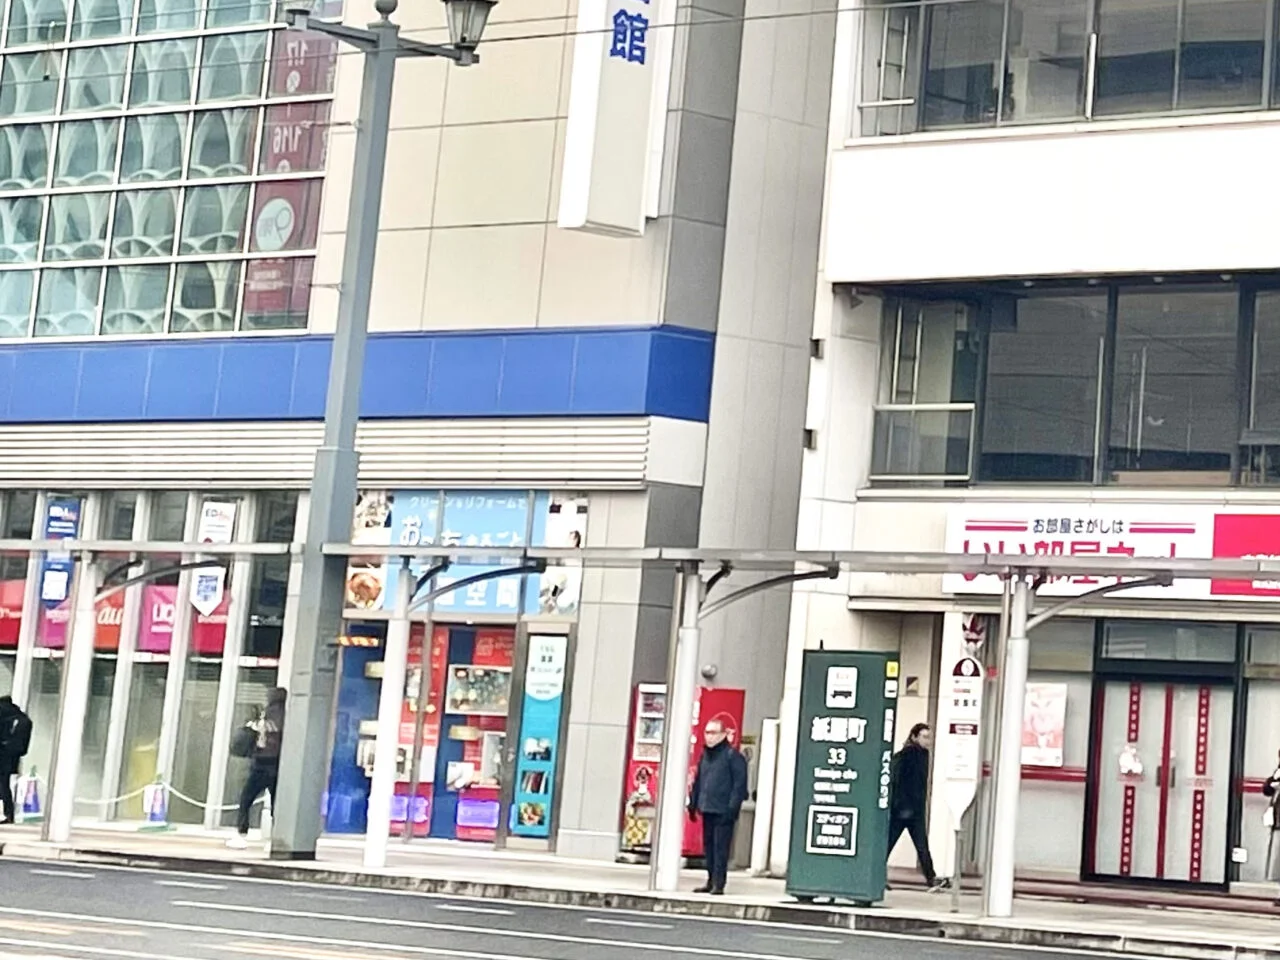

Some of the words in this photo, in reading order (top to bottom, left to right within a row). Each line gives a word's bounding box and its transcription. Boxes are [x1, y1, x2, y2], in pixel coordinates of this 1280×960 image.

[1033, 517, 1124, 534] お部屋さがしは
